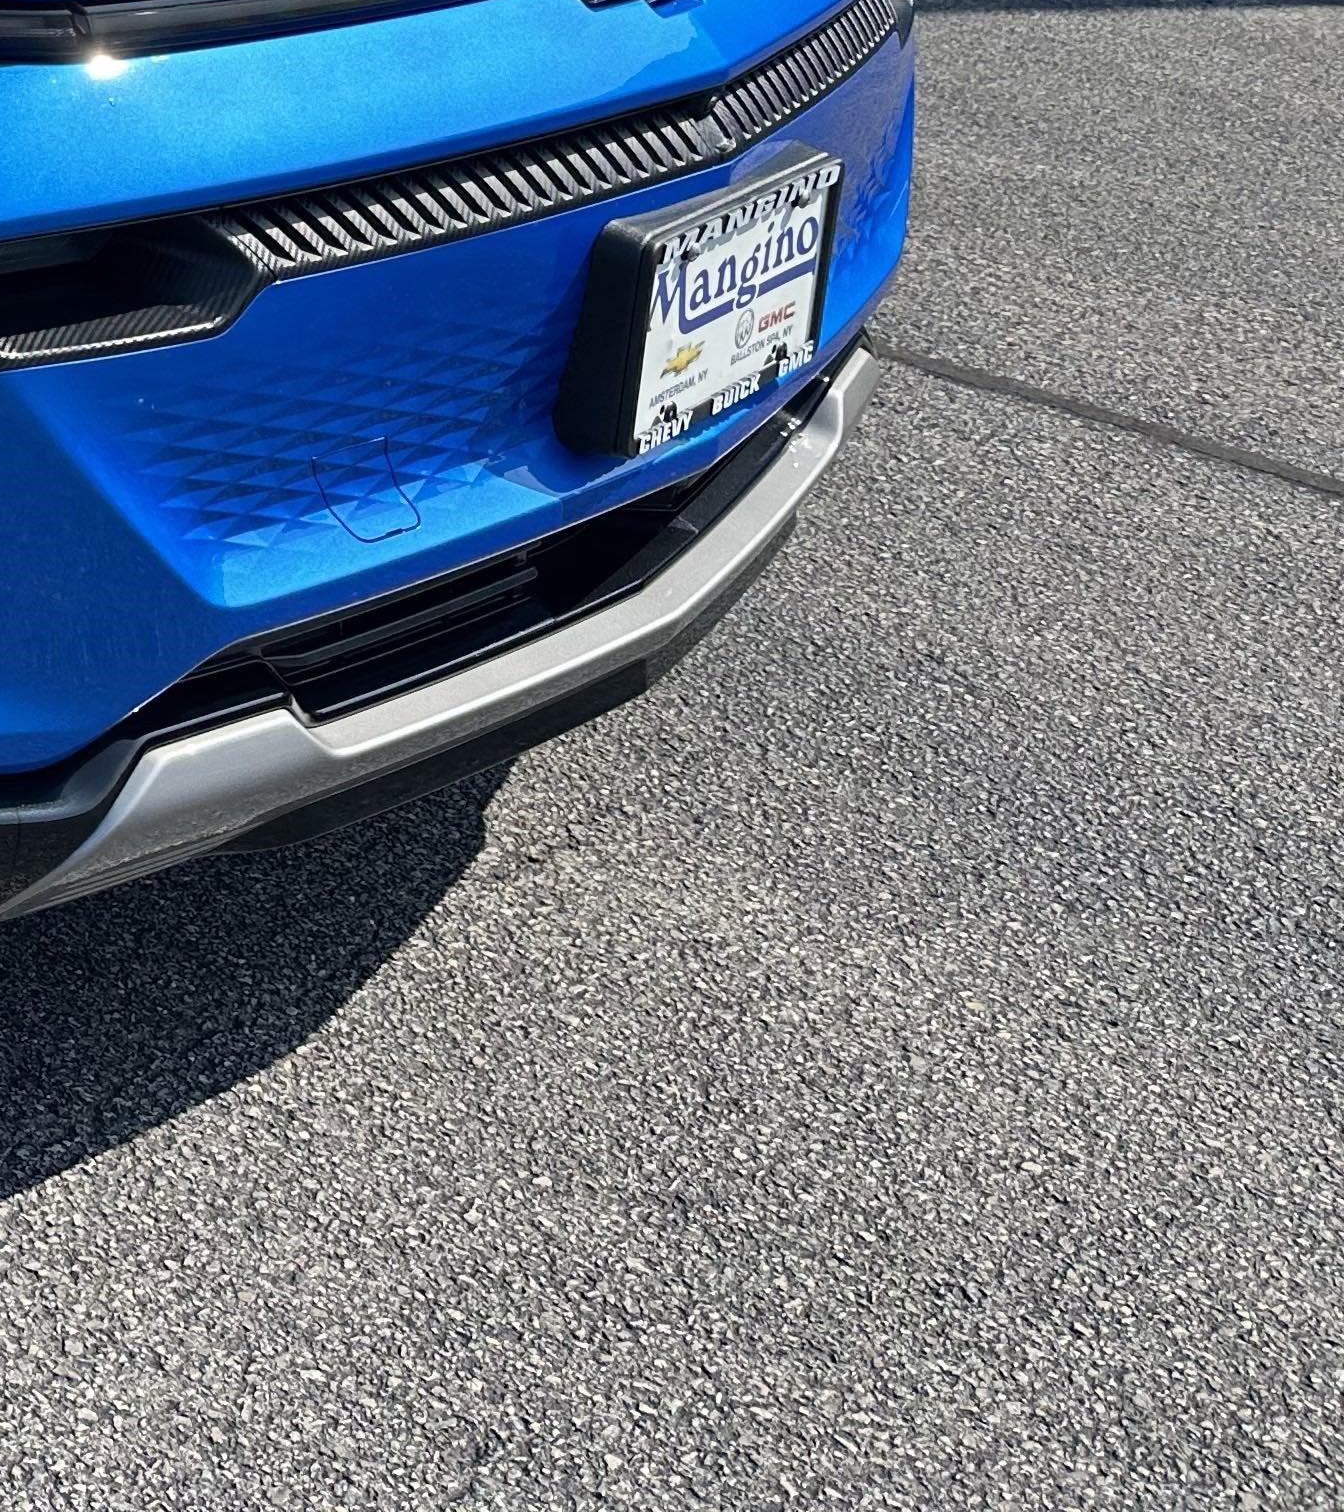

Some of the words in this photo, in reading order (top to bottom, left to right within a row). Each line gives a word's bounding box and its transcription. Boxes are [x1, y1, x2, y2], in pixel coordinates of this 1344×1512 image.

[662, 165, 841, 265] MANGINO
[648, 216, 820, 334] Mangino
[758, 300, 796, 333] GMC
[782, 324, 794, 339] NY
[697, 368, 709, 383] NY
[778, 339, 815, 379] GMC
[711, 372, 761, 416] BUICK
[638, 408, 694, 455] CHEVY
